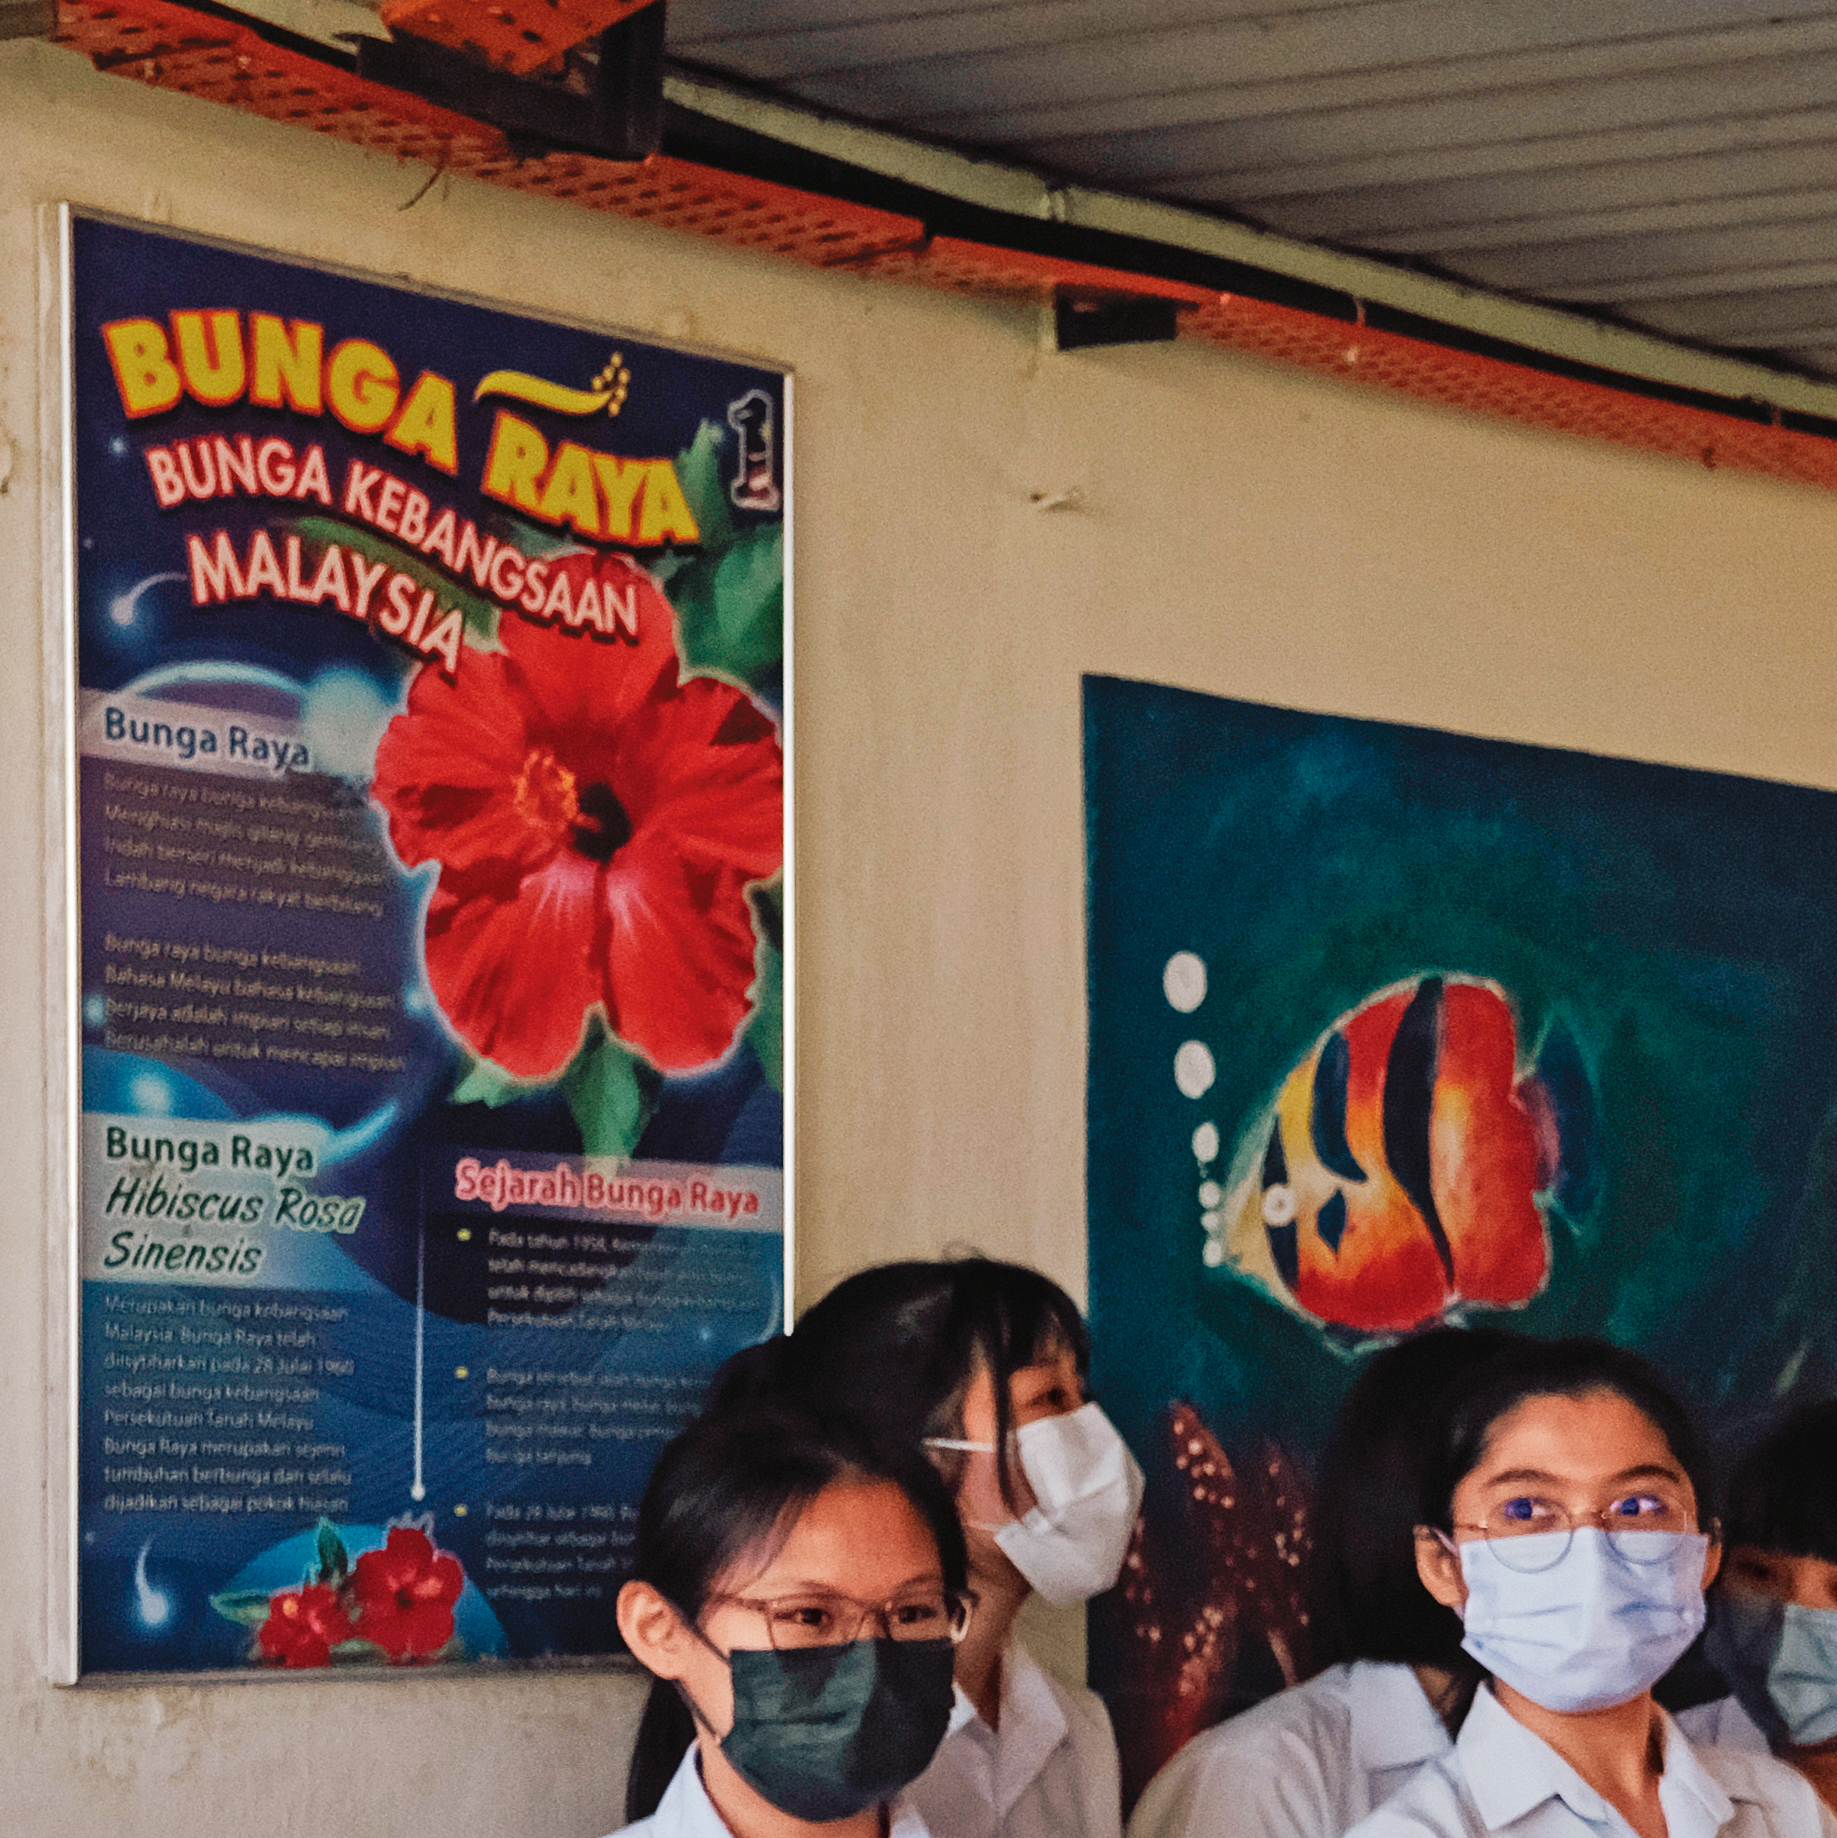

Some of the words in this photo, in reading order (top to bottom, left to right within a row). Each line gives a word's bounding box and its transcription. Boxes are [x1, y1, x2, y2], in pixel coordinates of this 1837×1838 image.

[104, 309, 459, 475] BUNGA
[482, 410, 700, 544] RAYA
[147, 435, 332, 508] BUNGA
[343, 460, 638, 636] KEBANGSAAN
[188, 529, 465, 674] MALAYSIA
[105, 707, 217, 758] Bunga
[228, 726, 310, 770] Raya
[106, 1127, 219, 1171] Bunga
[231, 1135, 314, 1176] Raya
[105, 1176, 263, 1223] Hibiscus
[276, 1188, 361, 1229] Rosa
[459, 1160, 576, 1208] Sejarah
[586, 1178, 680, 1214] Bunga
[691, 1182, 759, 1216] Raya
[104, 1231, 263, 1273] Sinensis
